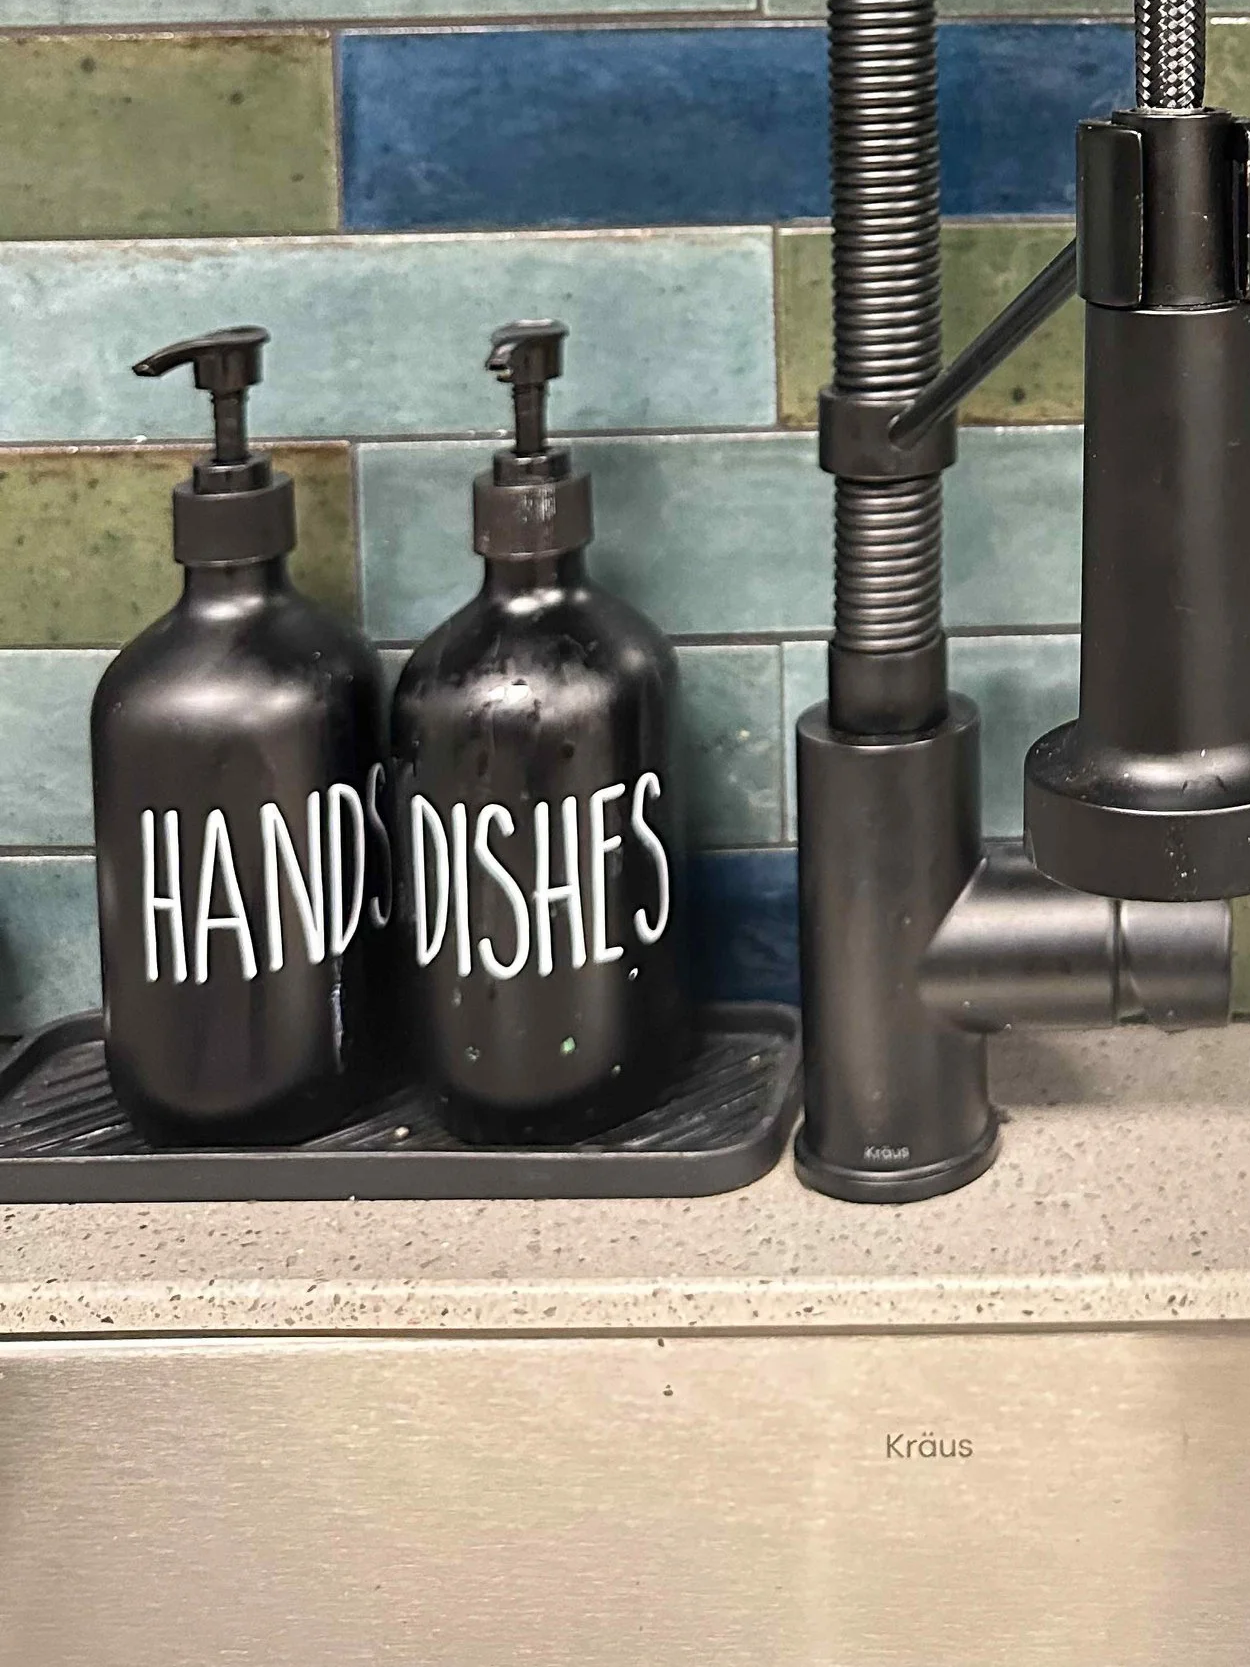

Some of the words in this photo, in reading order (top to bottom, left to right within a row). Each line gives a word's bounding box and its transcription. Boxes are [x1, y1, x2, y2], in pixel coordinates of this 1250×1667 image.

[141, 762, 393, 983] HANDS
[411, 771, 669, 979] DISHES
[886, 1431, 973, 1458] Kräus
